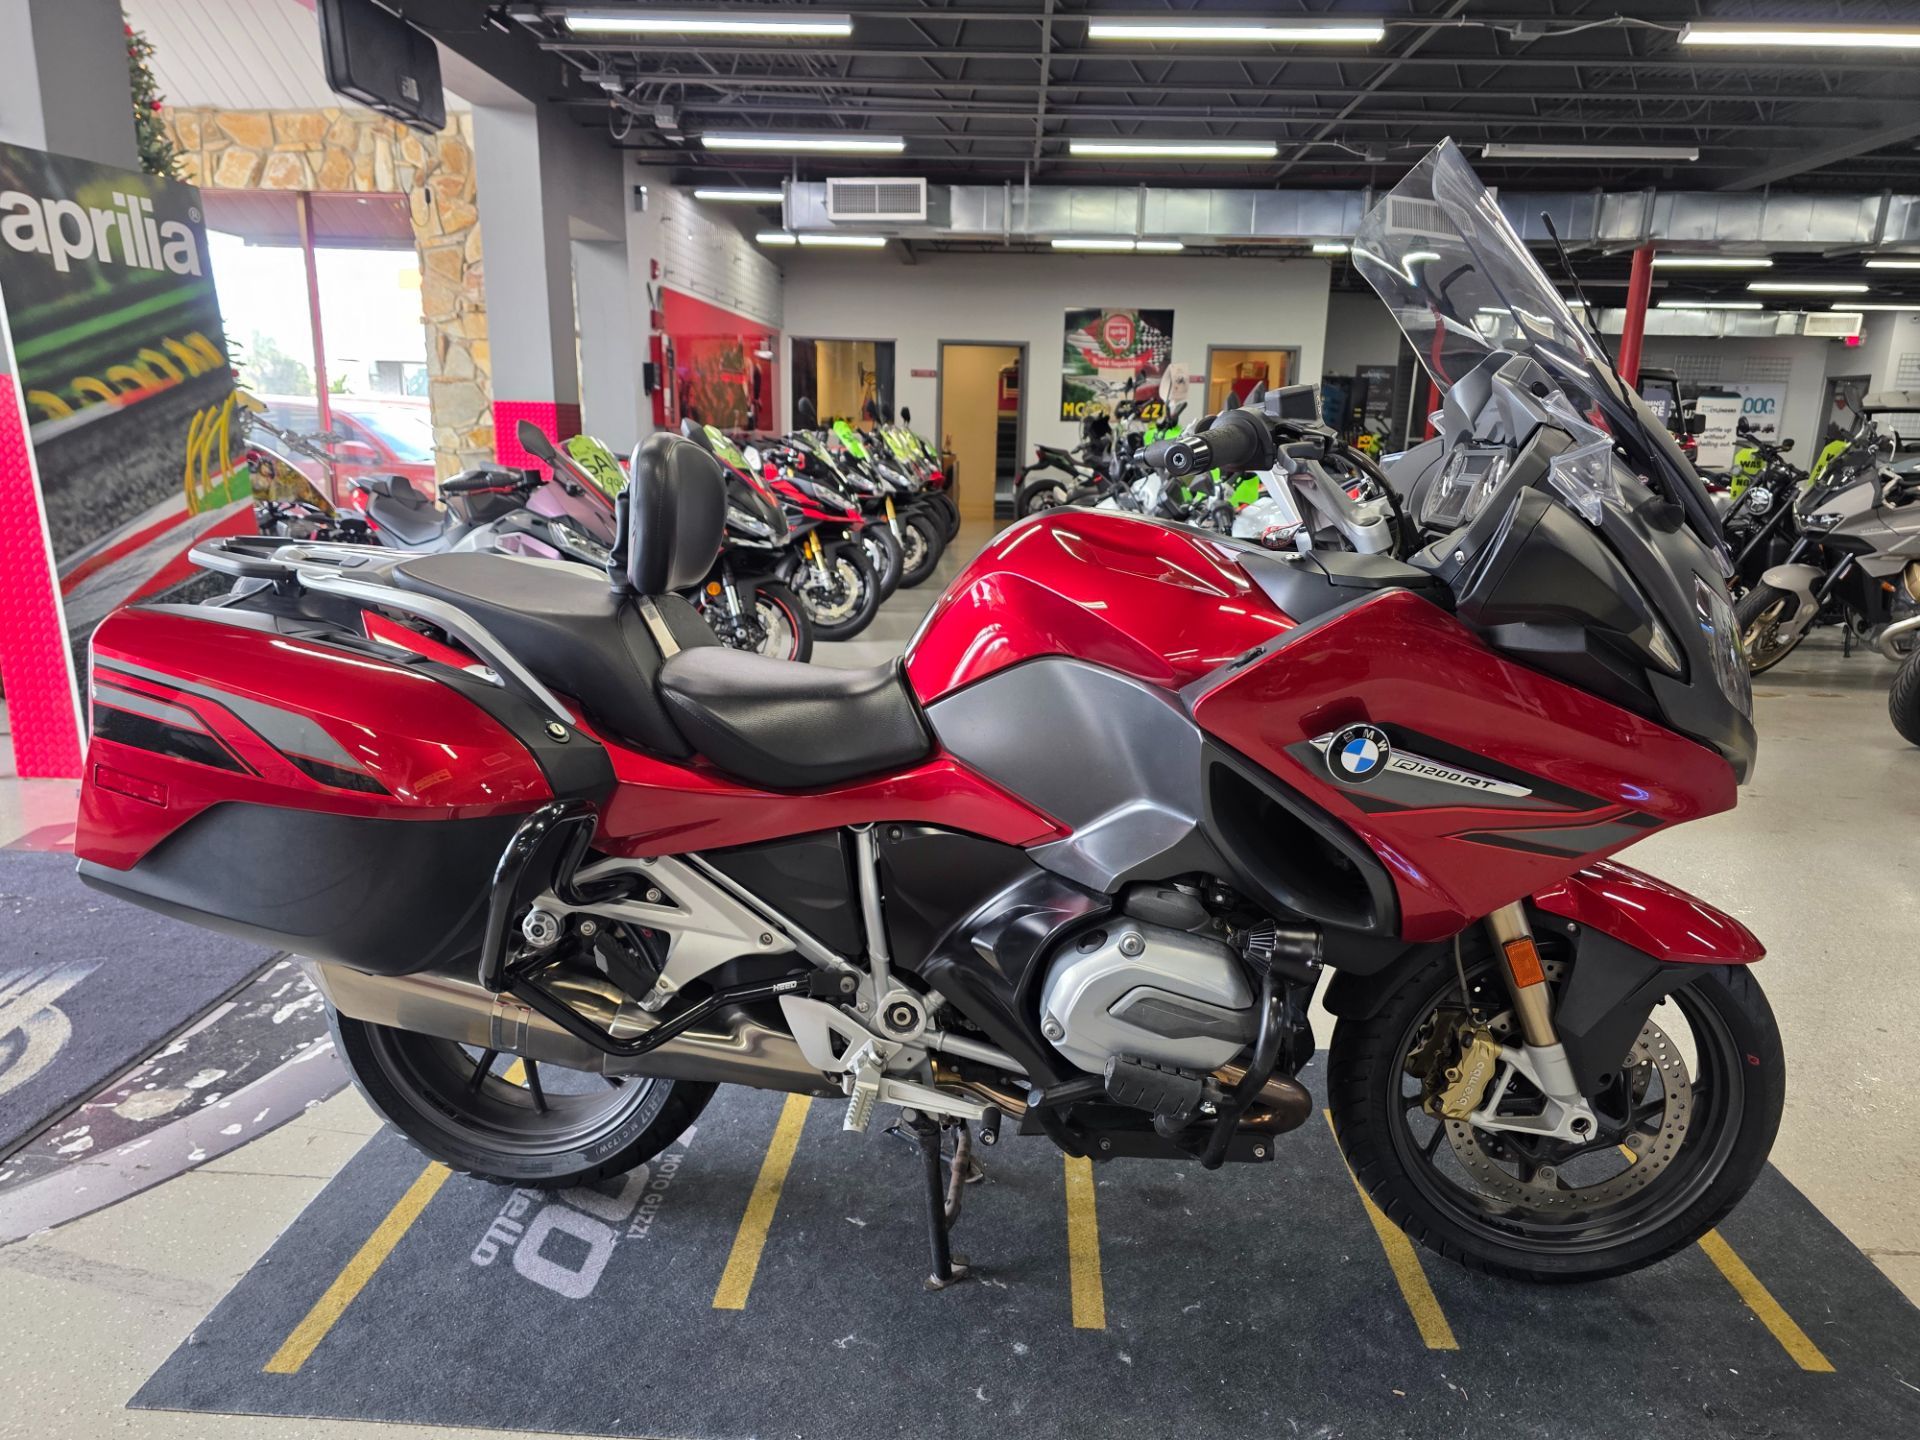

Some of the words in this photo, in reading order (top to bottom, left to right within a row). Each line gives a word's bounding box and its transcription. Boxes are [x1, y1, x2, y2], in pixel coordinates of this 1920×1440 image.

[0, 190, 202, 276] aprilia
[1343, 728, 1389, 752] BMW
[1392, 758, 1497, 790] R1200RT
[773, 980, 798, 993] HEED
[1456, 1061, 1485, 1106] brembo
[651, 1153, 684, 1189] MOTO
[626, 1193, 664, 1240] GUZZI
